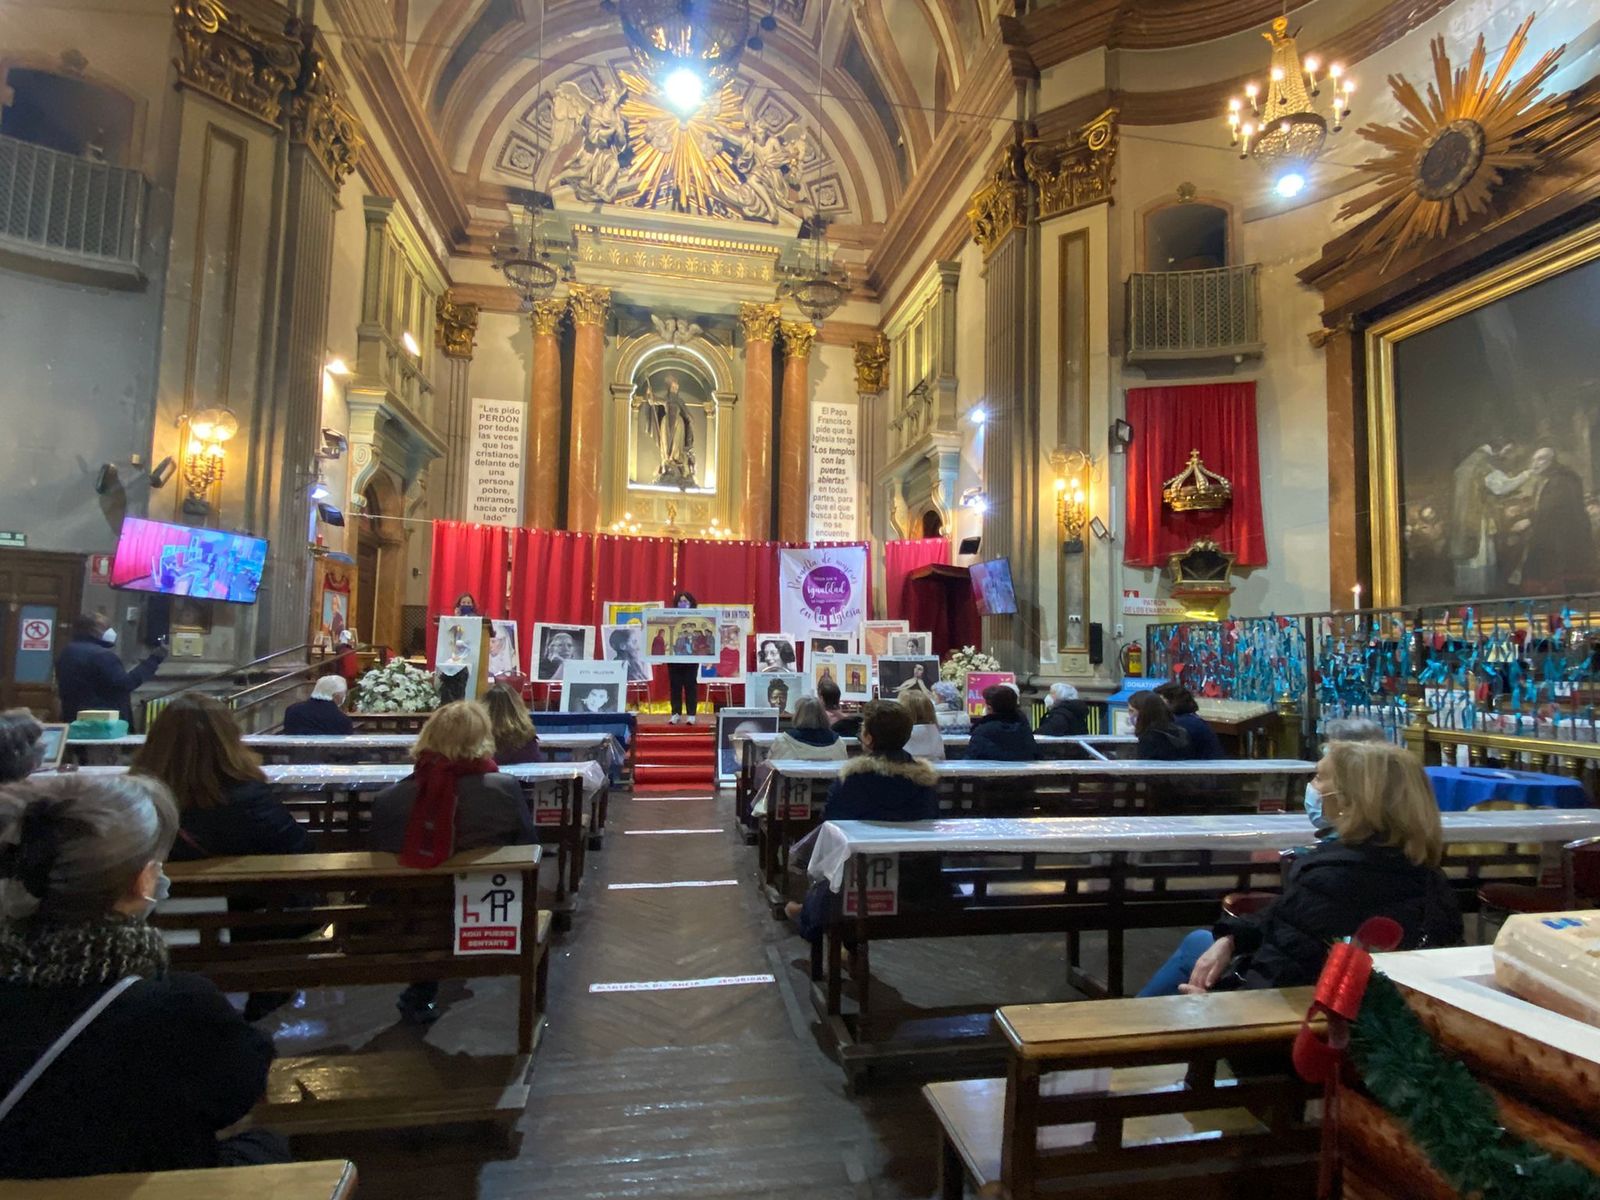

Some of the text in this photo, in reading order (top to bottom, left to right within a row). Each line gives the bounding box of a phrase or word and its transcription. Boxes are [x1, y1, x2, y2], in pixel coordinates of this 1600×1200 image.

[822, 407, 848, 417] El Papa
[818, 416, 851, 426] Francisco
[816, 425, 830, 434] pide
[812, 434, 855, 445] Iglesia tenga
[501, 442, 513, 450] los
[476, 450, 518, 459] cristianos
[829, 447, 856, 456] templos
[474, 459, 506, 468] delante
[835, 457, 845, 465] las
[820, 466, 846, 476] puertas
[482, 486, 510, 495] pobre,
[828, 485, 848, 494] todas
[477, 496, 514, 504] miramos
[474, 504, 497, 512] hacia
[830, 502, 836, 510] el
[811, 511, 831, 520] busca
[840, 512, 854, 520] Dios
[815, 529, 849, 538] encuentre
[807, 581, 846, 598] igualdad
